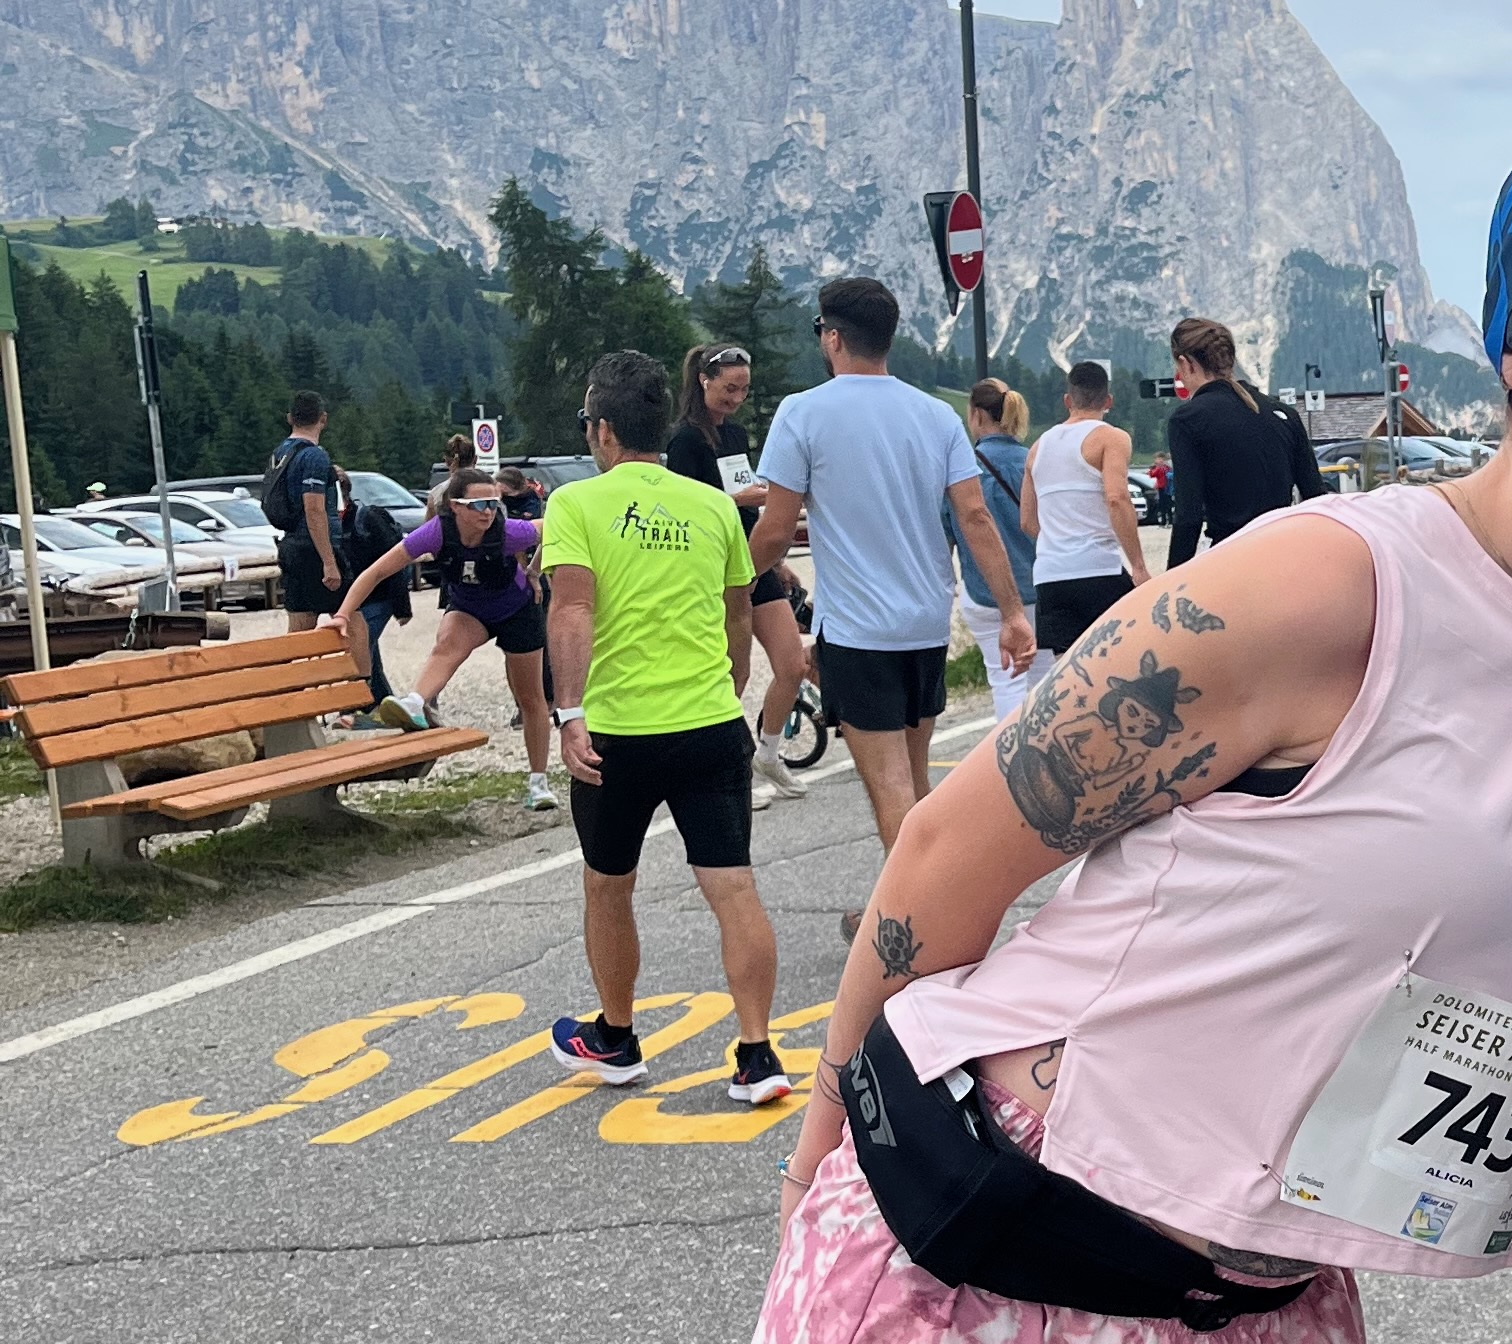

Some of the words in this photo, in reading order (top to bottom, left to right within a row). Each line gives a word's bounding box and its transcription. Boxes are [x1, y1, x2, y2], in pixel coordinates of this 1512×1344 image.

[640, 528, 689, 544] TRAIL
[1415, 1010, 1506, 1057] SEISER
[1404, 1036, 1440, 1055] HALF
[1442, 1050, 1512, 1082] MARATHON
[1424, 1167, 1474, 1189] ALICIA
